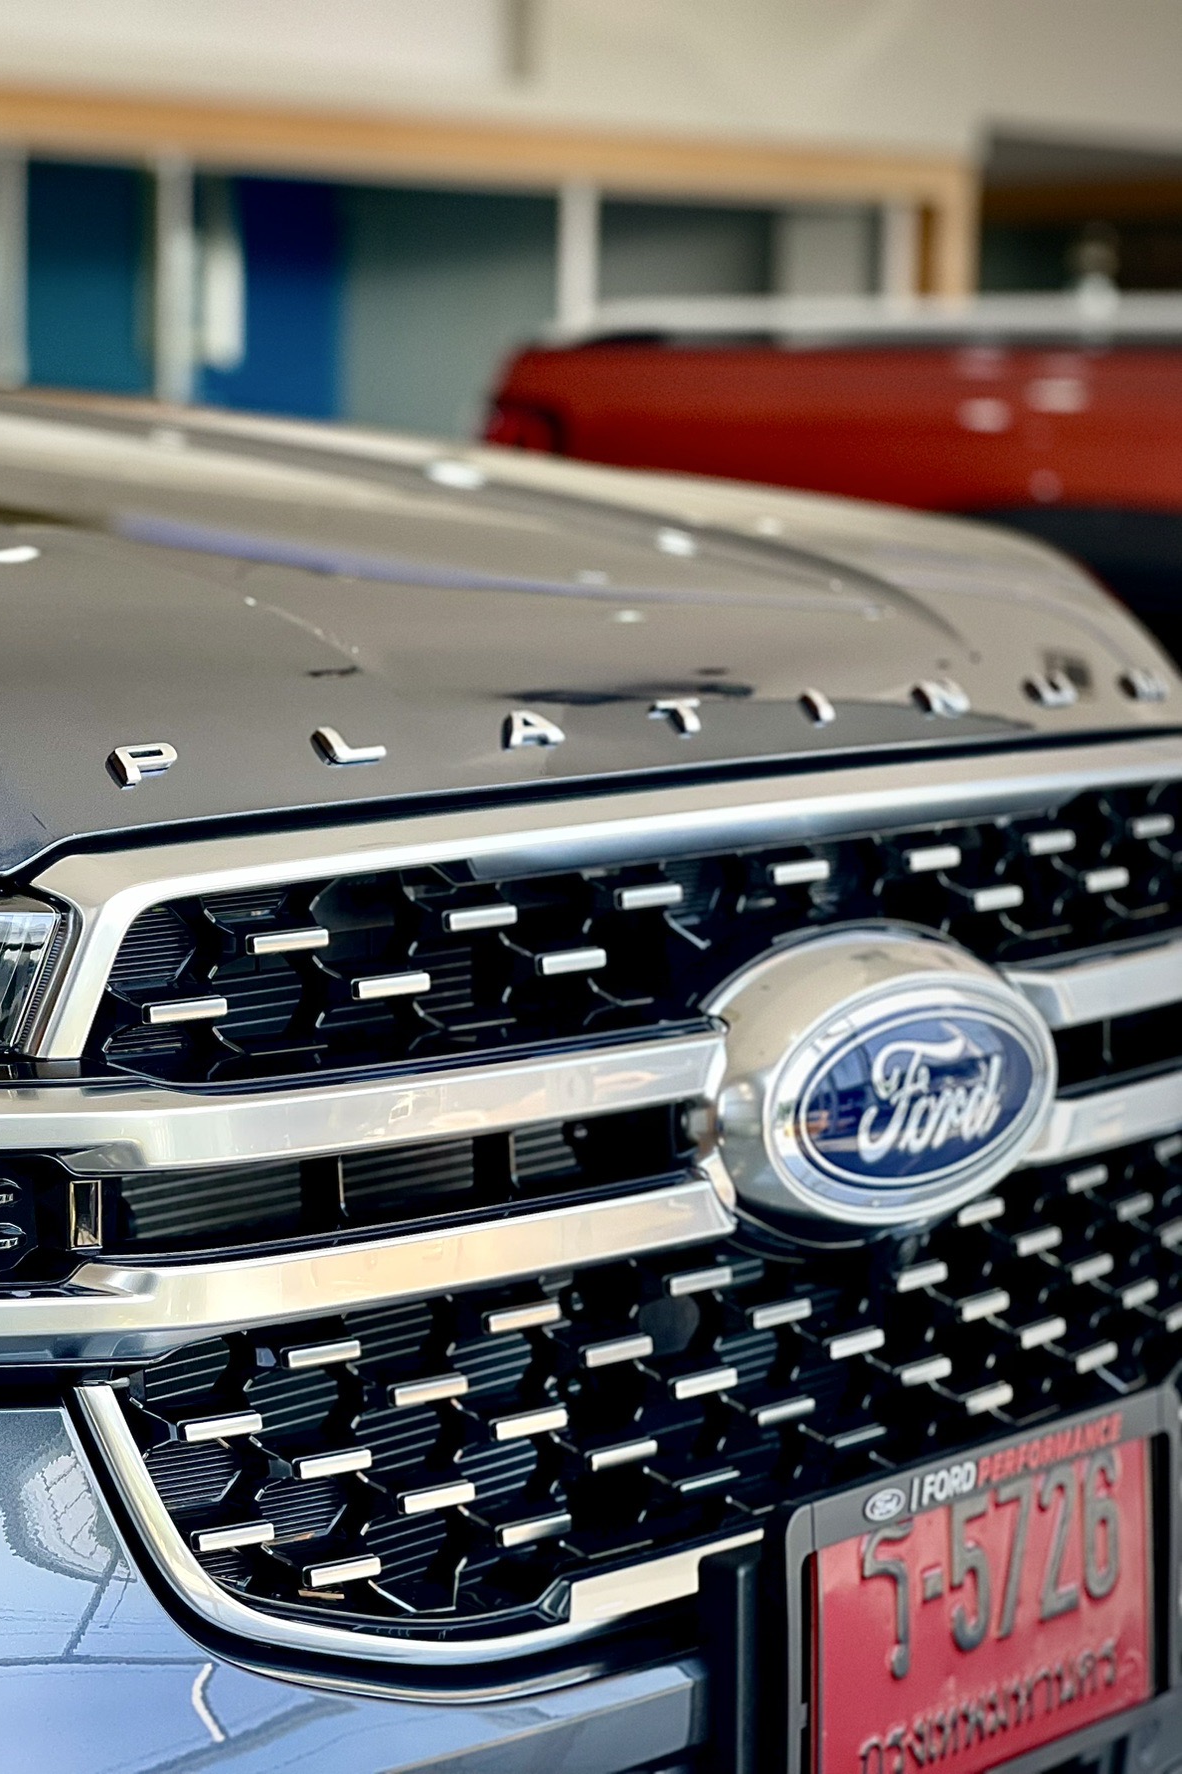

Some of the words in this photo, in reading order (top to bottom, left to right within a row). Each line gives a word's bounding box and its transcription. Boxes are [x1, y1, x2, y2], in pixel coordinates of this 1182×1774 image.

[858, 1040, 1002, 1163] Ford
[921, 1461, 978, 1507] FORD
[977, 1412, 1122, 1487] PERFORMANCE
